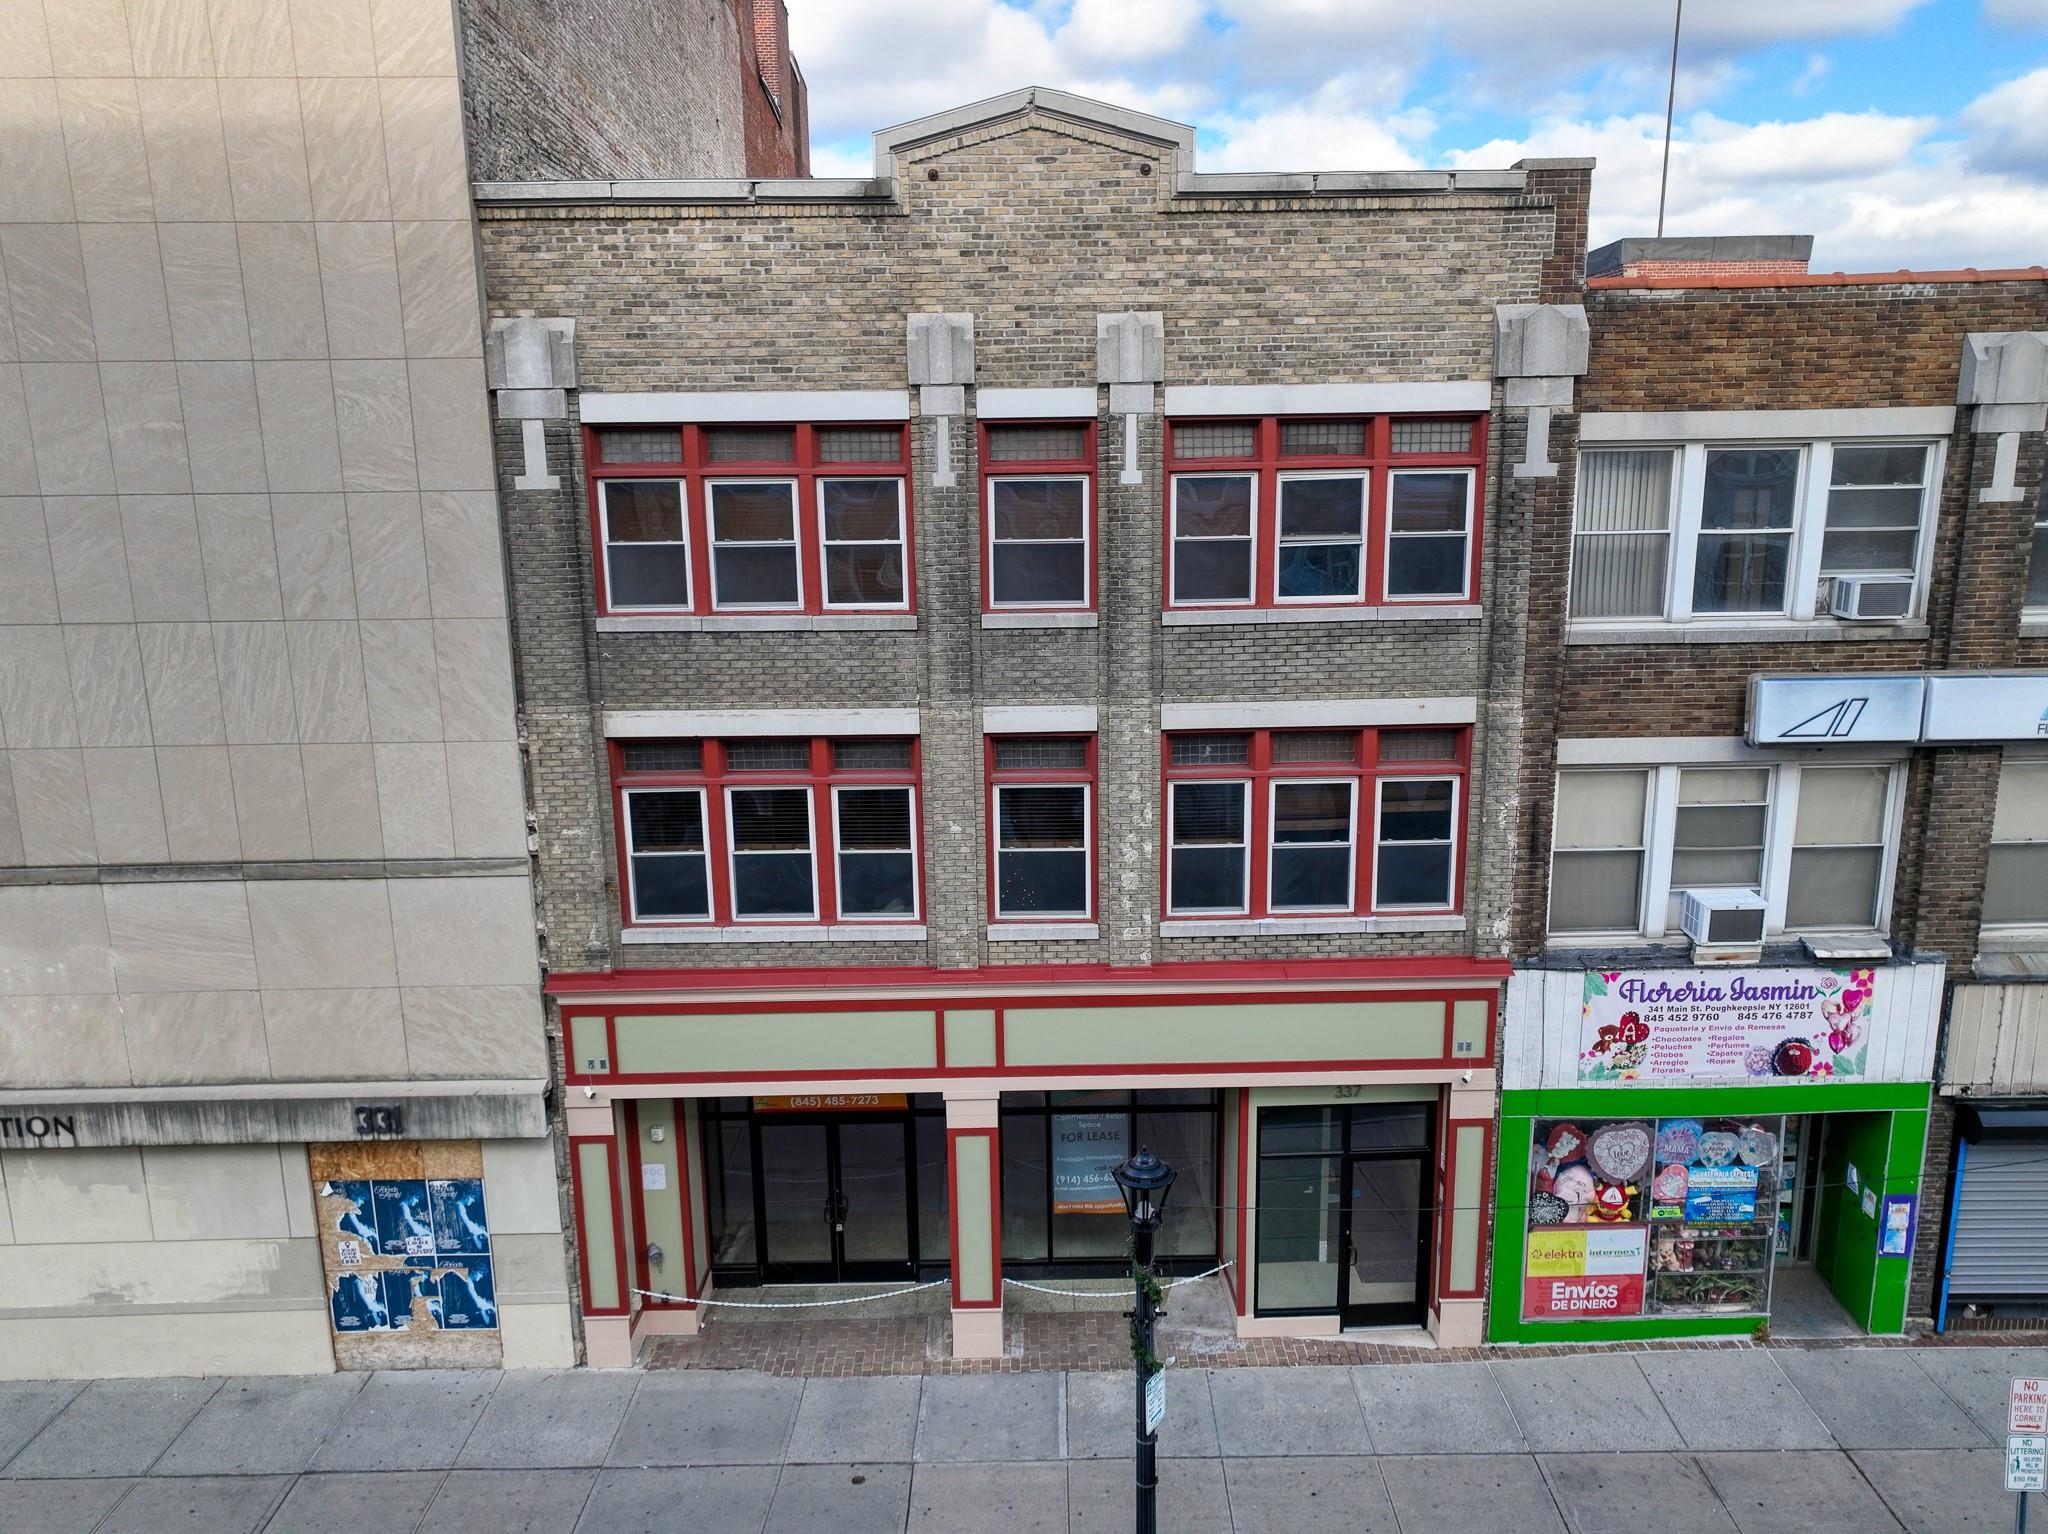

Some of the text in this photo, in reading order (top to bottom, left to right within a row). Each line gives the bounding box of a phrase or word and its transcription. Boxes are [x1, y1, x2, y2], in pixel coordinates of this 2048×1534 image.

[1619, 979, 1727, 1003] Floreria
[1648, 1005, 1664, 1014] 341
[1667, 1005, 1688, 1013] Main
[1690, 1004, 1702, 1012] St.
[1705, 1003, 1766, 1014] Poughkeepsie
[1768, 1003, 1781, 1011] NY
[1643, 1011, 1814, 1022] 845 452 9760 845 476 4787
[1335, 1084, 1362, 1098] 337
[790, 1095, 880, 1108] (845) 485-7273
[354, 1105, 403, 1135] 331
[1078, 1120, 1101, 1129] Space
[0, 1115, 76, 1137] TION
[1061, 1130, 1120, 1143] FOR LEASE
[643, 1167, 663, 1176] FDC
[1056, 1174, 1081, 1185] (914)
[1544, 1249, 1584, 1259] elektra
[1589, 1248, 1636, 1258] intermex
[1551, 1281, 1618, 1299] Envíos
[1551, 1299, 1618, 1311] DE DINERO
[2023, 1381, 2039, 1392] NO
[2013, 1393, 2047, 1405] PARKING
[2014, 1405, 2045, 1414] HERE TO
[2014, 1414, 2044, 1423] CORNER
[2022, 1439, 2032, 1447] NO
[2010, 1447, 2044, 1456] LITTERING
